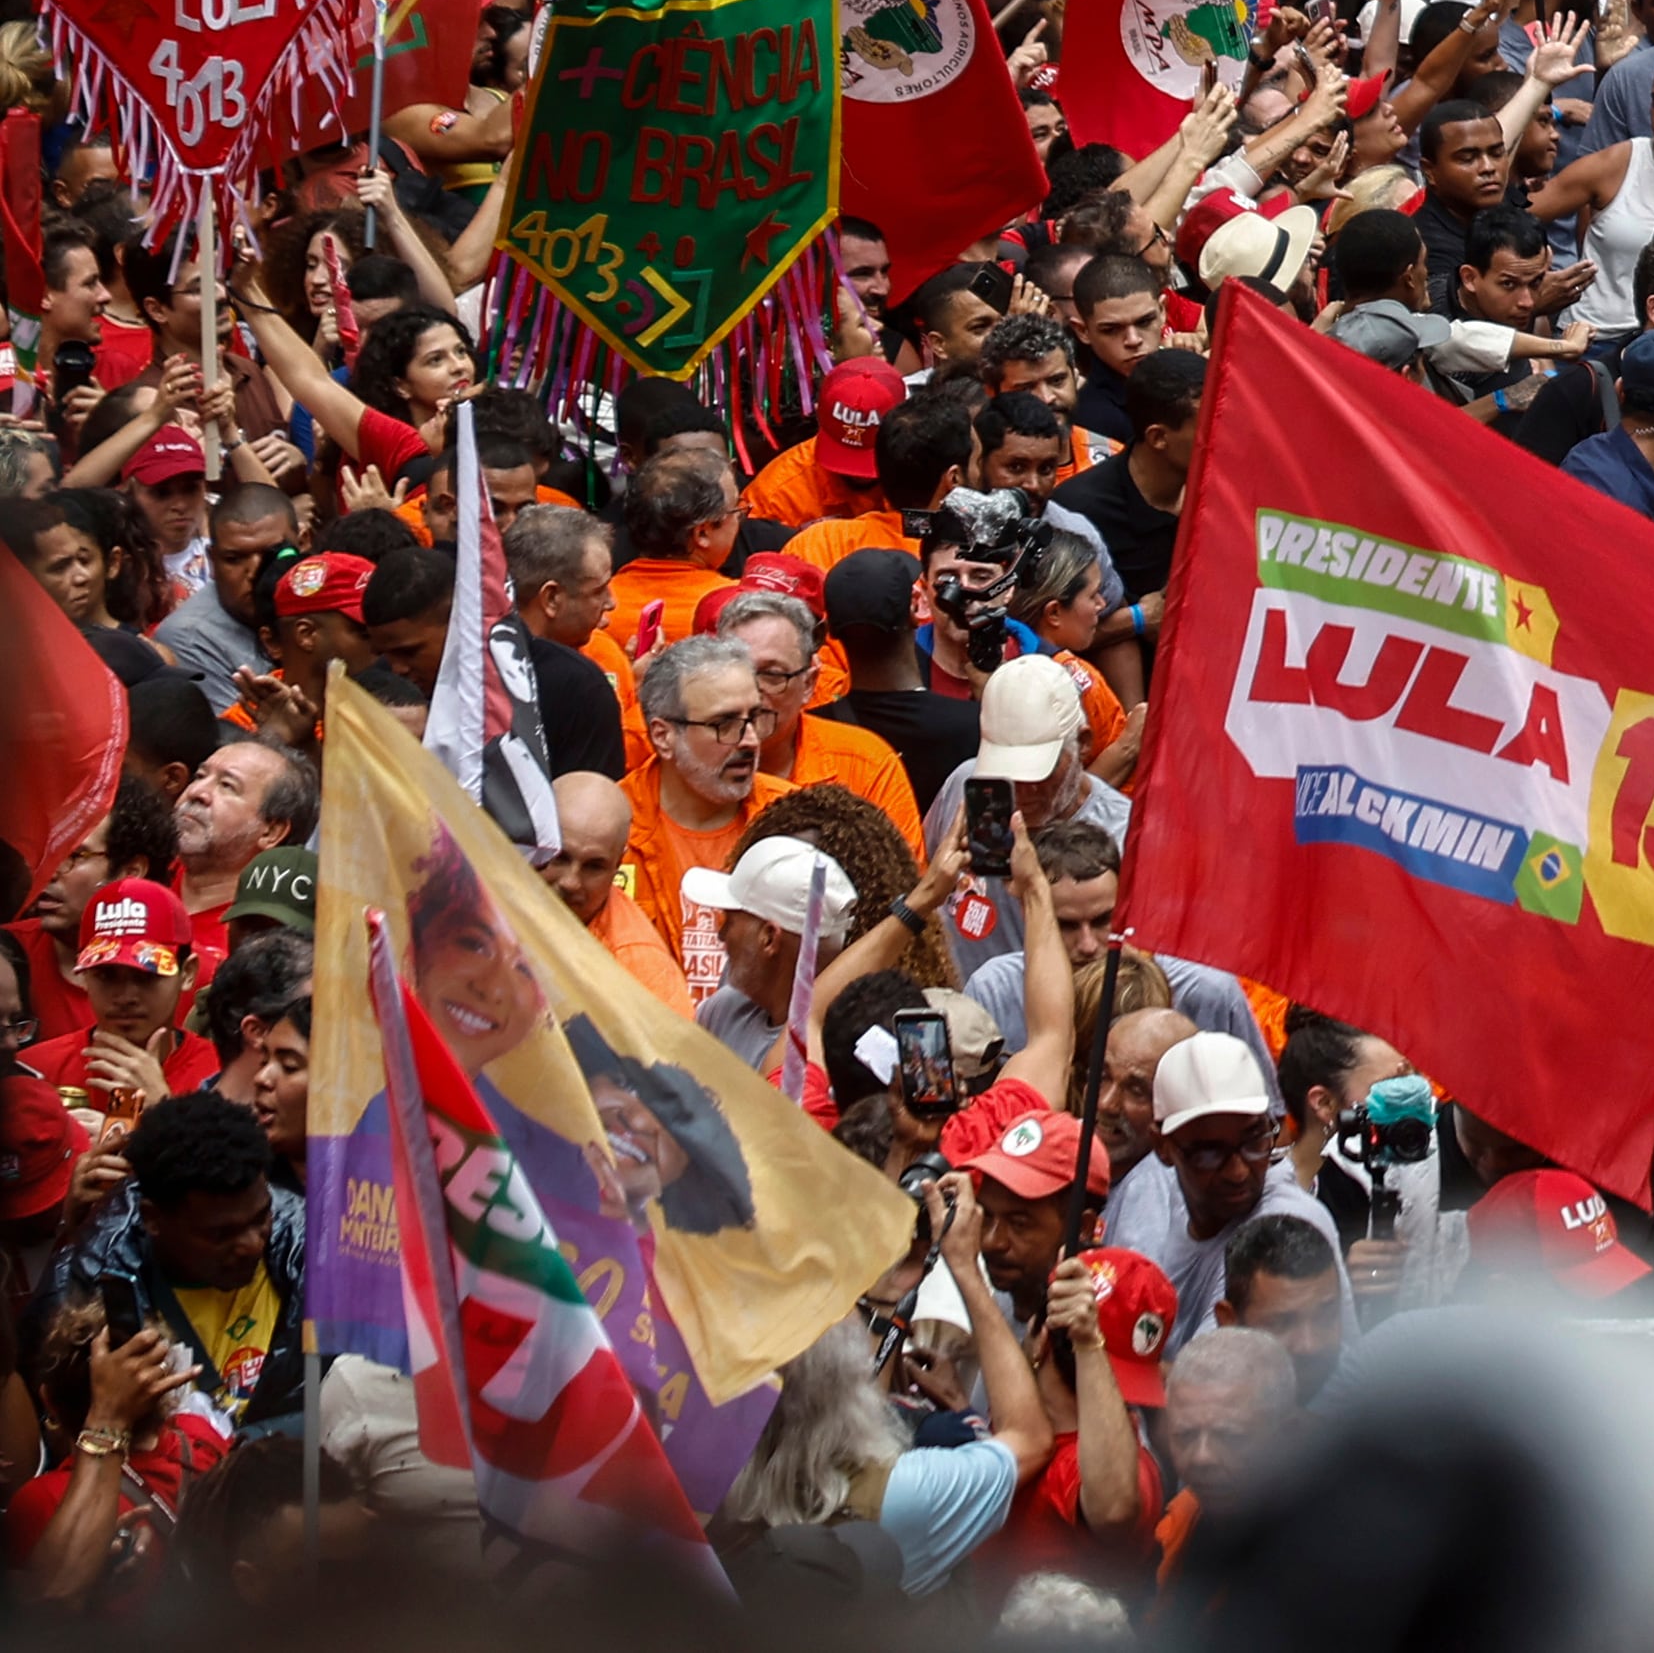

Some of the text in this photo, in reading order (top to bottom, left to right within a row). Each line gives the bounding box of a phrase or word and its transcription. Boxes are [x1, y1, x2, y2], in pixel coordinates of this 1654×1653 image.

[147, 37, 248, 147] 4013
[622, 16, 822, 119] CIÊNCIA
[894, 30, 970, 99] AGRICULTORES
[526, 139, 610, 208] NO
[511, 212, 626, 304] 4013
[832, 400, 880, 427] LULA
[1255, 510, 1499, 618] PRESIDENTE
[1247, 604, 1572, 786] LULA
[1317, 772, 1516, 874] ALCKMIN
[95, 896, 147, 921] Lula
[245, 864, 313, 901] NYC
